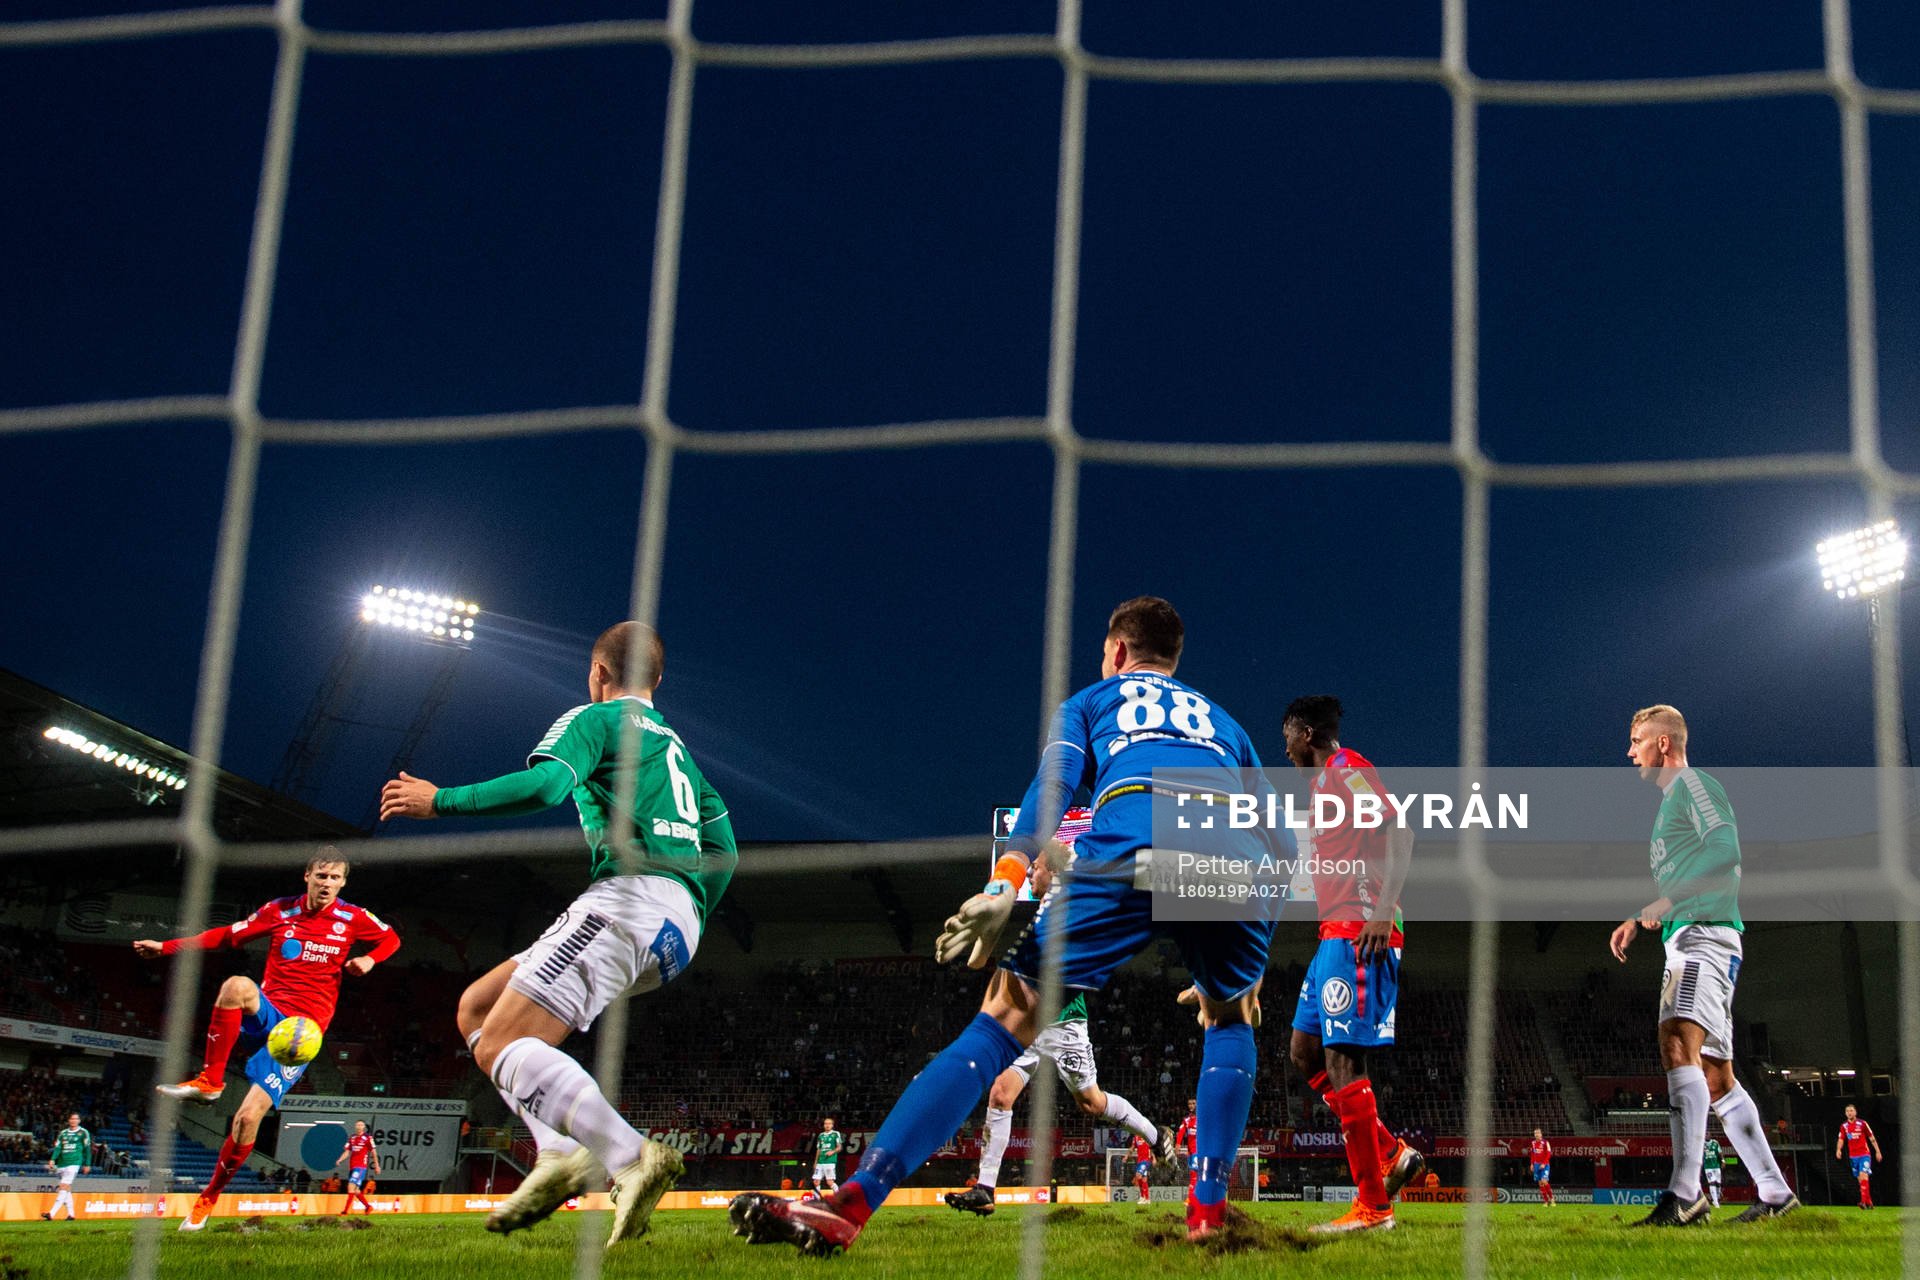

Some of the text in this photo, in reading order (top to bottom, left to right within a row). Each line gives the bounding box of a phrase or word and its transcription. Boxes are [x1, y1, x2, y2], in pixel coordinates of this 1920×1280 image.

[1117, 681, 1216, 740] 88
[665, 741, 699, 824] 6
[304, 940, 341, 955] Resurs
[302, 951, 329, 963] Bank
[1325, 1018, 1333, 1038] 8
[264, 1073, 282, 1089] 99
[730, 1128, 774, 1154] STÅ
[1566, 1146, 1599, 1156] FASTER
[1641, 1146, 1673, 1156] FOREV
[369, 1150, 409, 1170] ank
[1407, 1190, 1433, 1202] min
